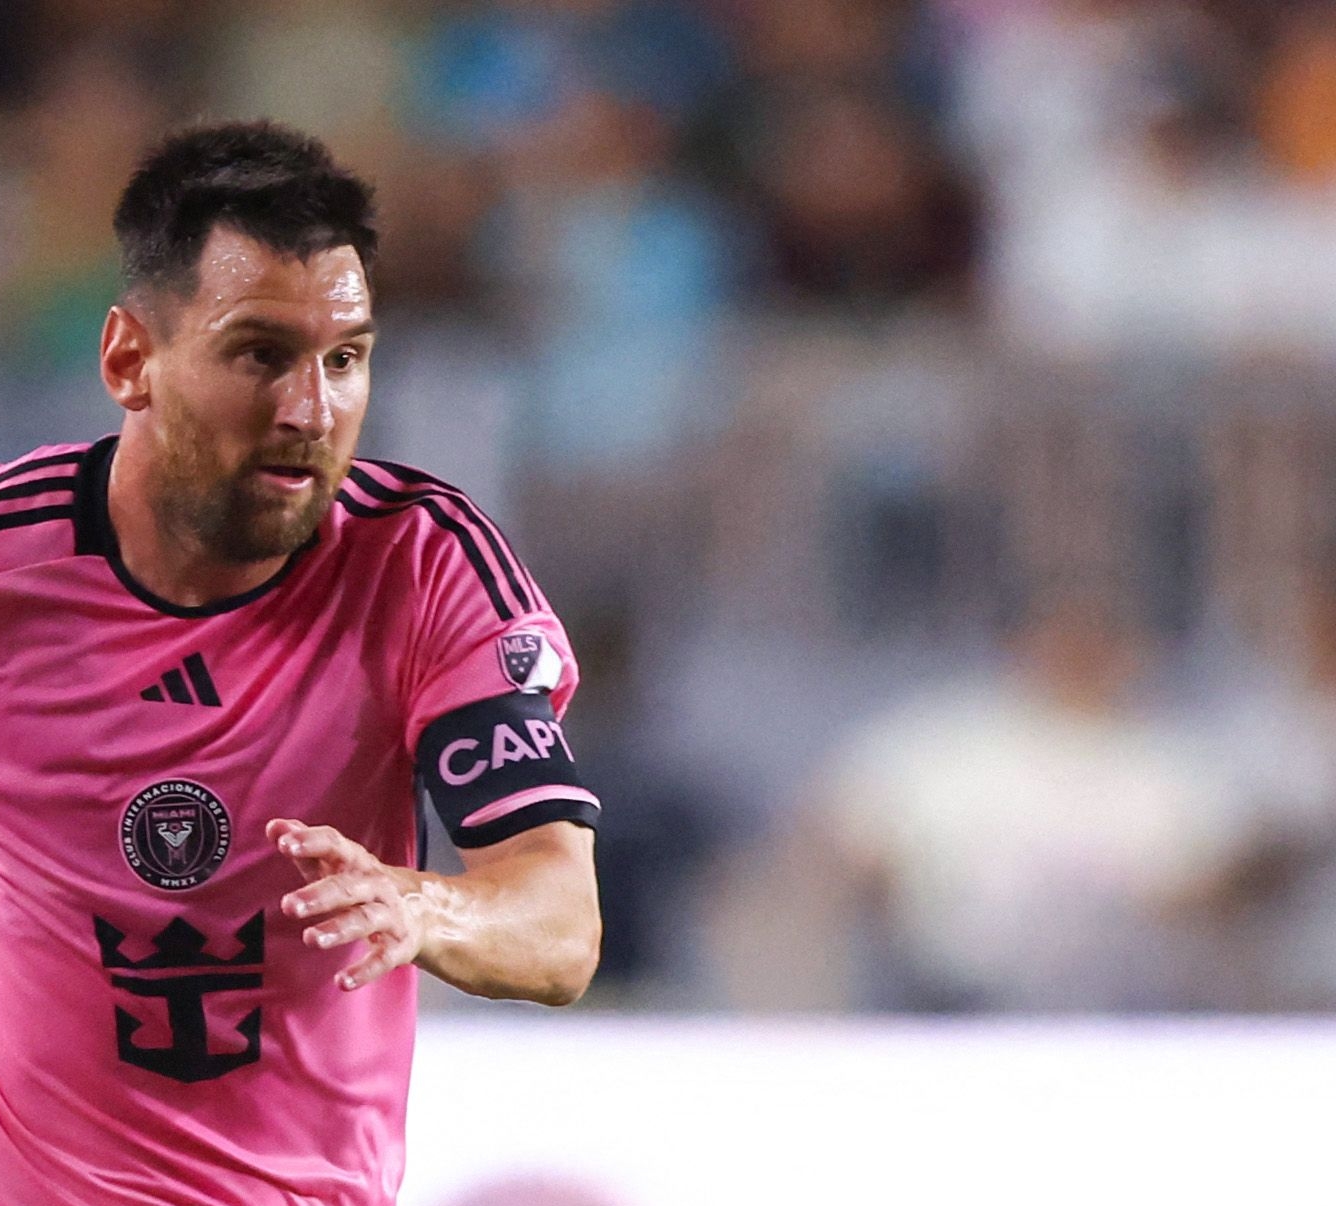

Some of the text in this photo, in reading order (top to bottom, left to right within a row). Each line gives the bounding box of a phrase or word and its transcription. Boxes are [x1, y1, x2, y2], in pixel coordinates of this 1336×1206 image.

[503, 637, 539, 656] MLS
[124, 784, 207, 832] INTERNACIONAL
[152, 809, 196, 818] MIAMI
[209, 802, 222, 815] DE
[124, 837, 140, 867] CLUB
[160, 877, 197, 887] MMXX
